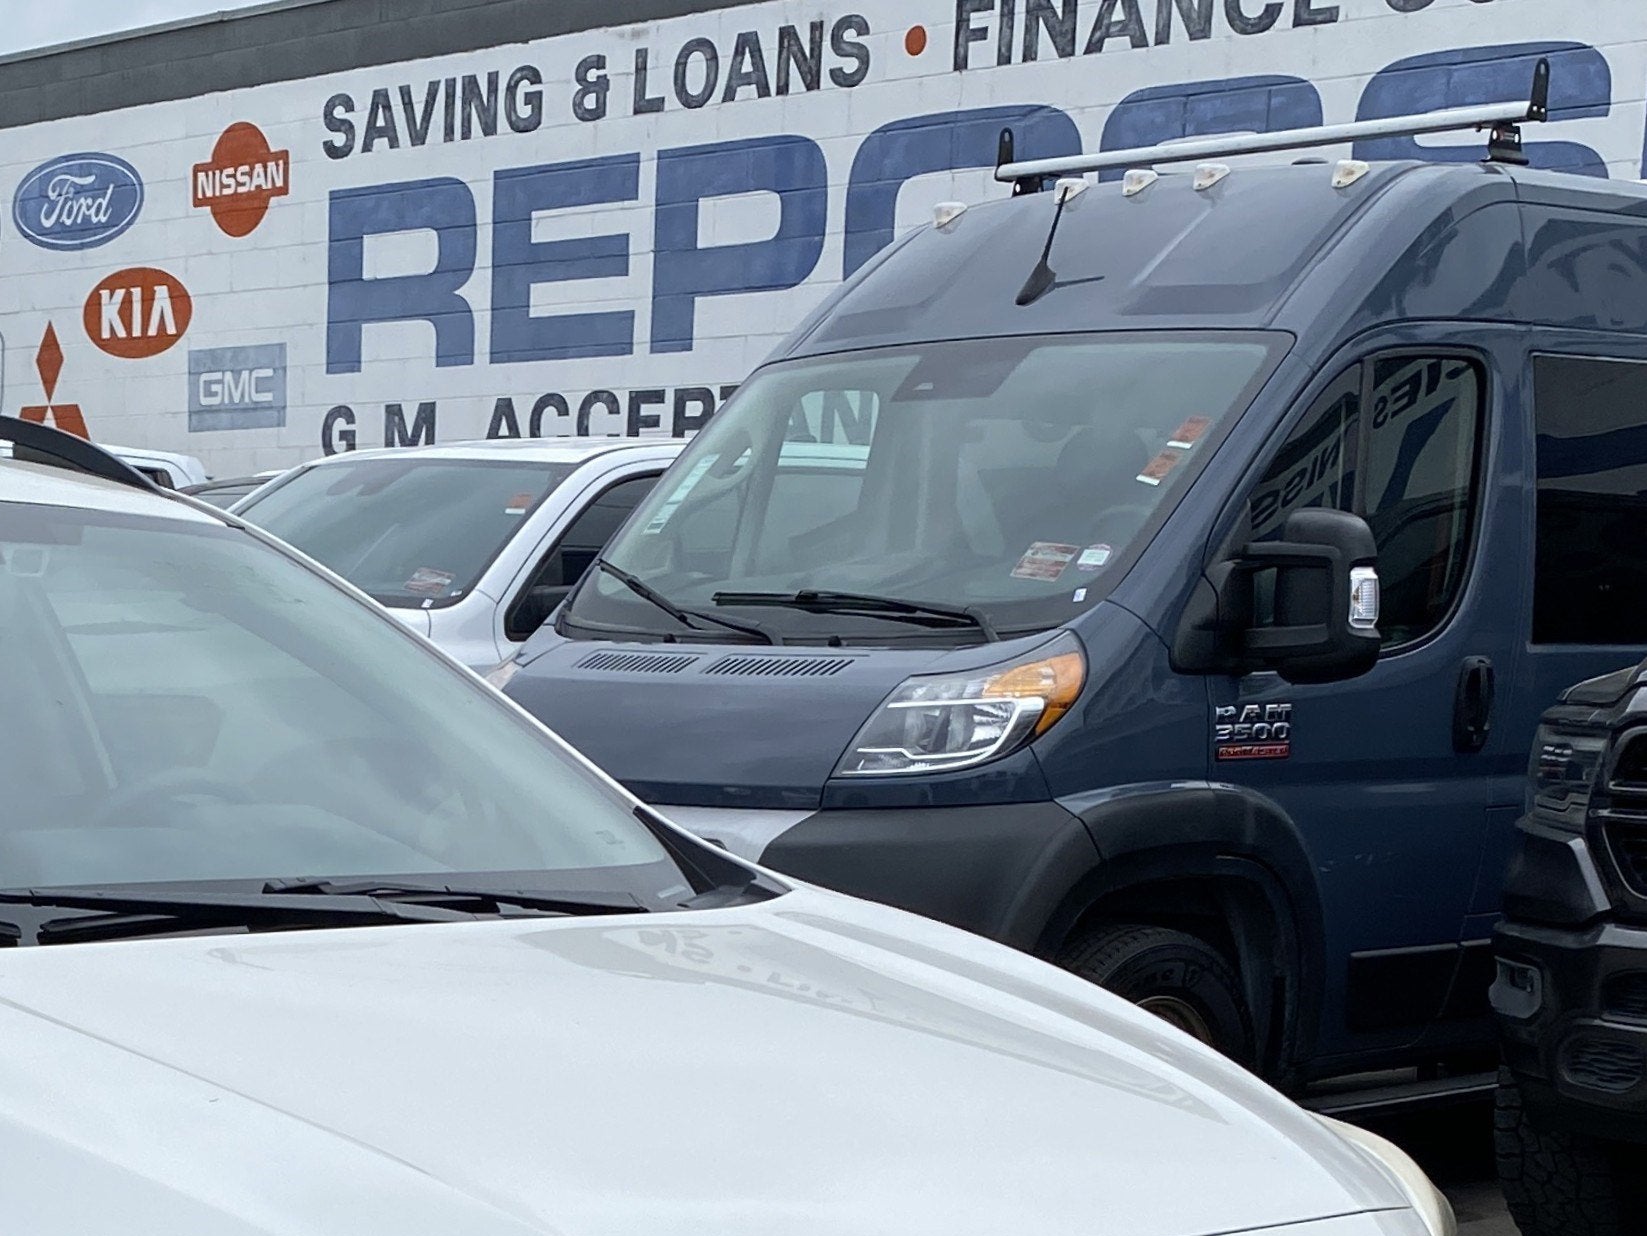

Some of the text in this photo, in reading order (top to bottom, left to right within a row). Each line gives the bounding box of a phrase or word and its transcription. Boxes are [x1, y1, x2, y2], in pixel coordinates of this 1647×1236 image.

[322, 14, 871, 160] SAVING & LOANS
[40, 174, 113, 227] Ford
[196, 159, 284, 199] NISSAN
[99, 285, 177, 340] KIA
[198, 368, 274, 406] GMC
